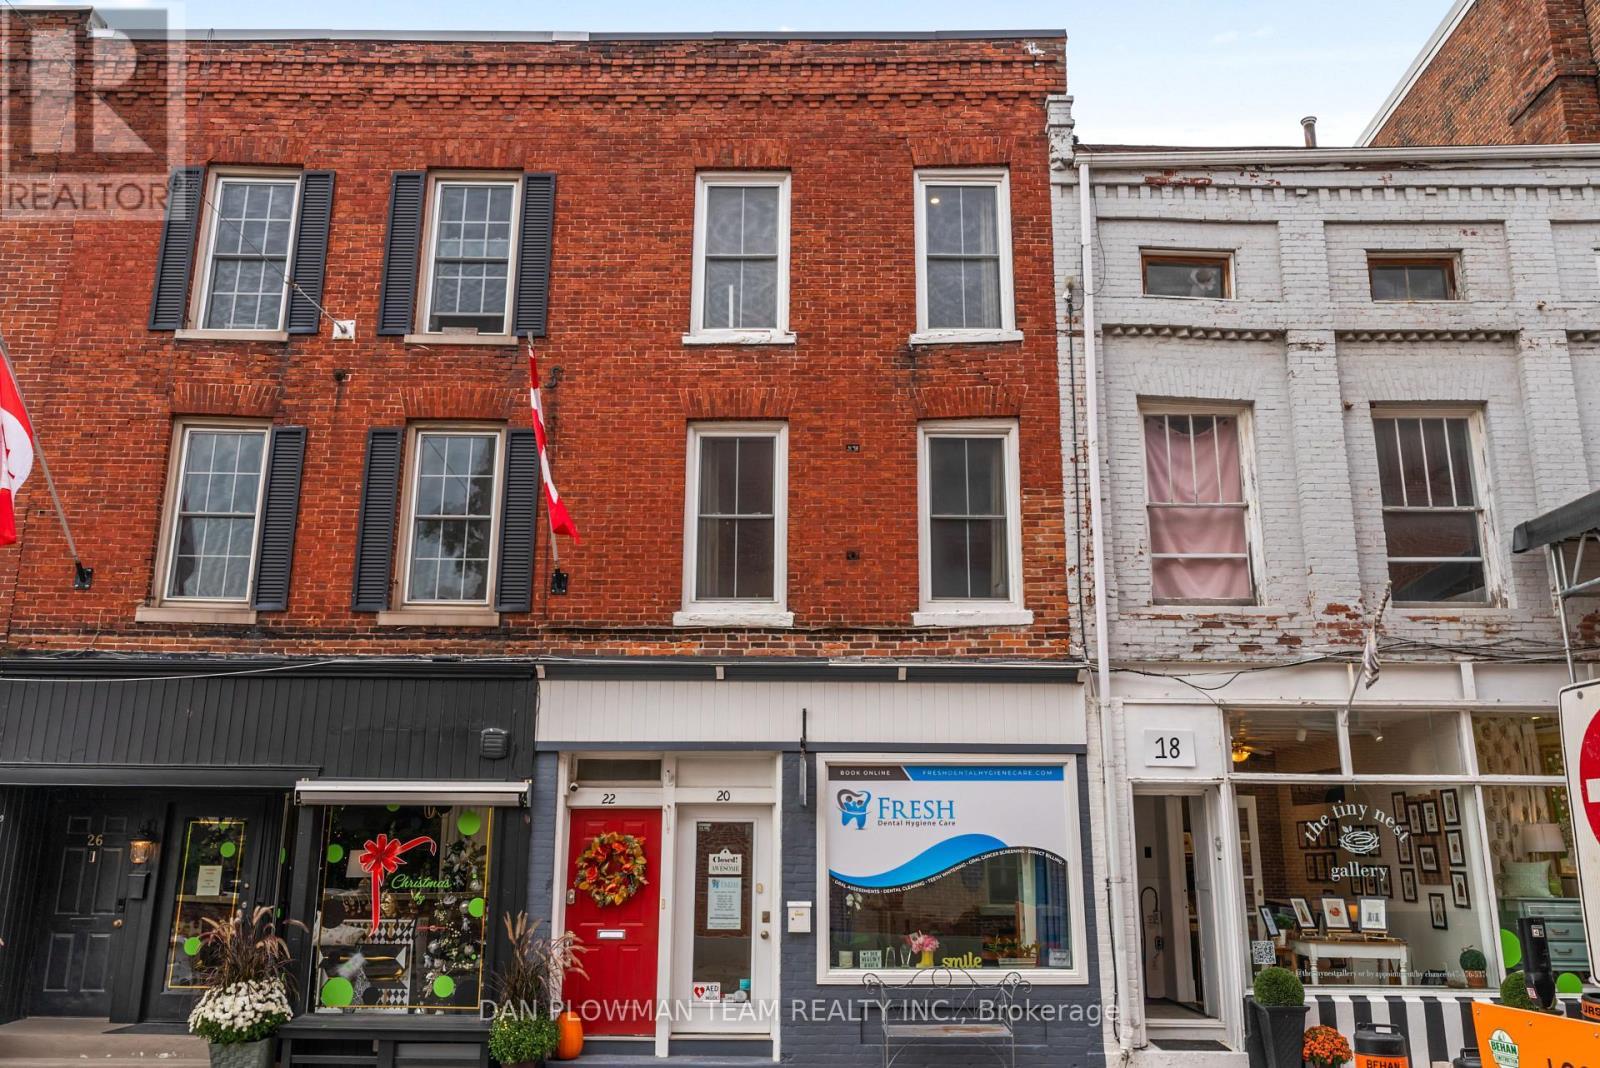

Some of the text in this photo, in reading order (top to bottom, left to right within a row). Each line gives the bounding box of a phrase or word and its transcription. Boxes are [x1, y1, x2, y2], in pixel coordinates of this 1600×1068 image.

[1155, 737, 1181, 758] 18
[601, 793, 616, 804] 22
[716, 790, 731, 801] 20
[877, 797, 955, 820] FRESH
[905, 820, 937, 828] Hygiene
[1305, 800, 1409, 844] the tiny nest
[87, 834, 103, 846] 26
[927, 874, 942, 883] TEETH
[1331, 862, 1388, 881] gallery
[391, 873, 451, 889] Christmas
[942, 951, 982, 968] smile
[1490, 1041, 1517, 1055] BEHAN
